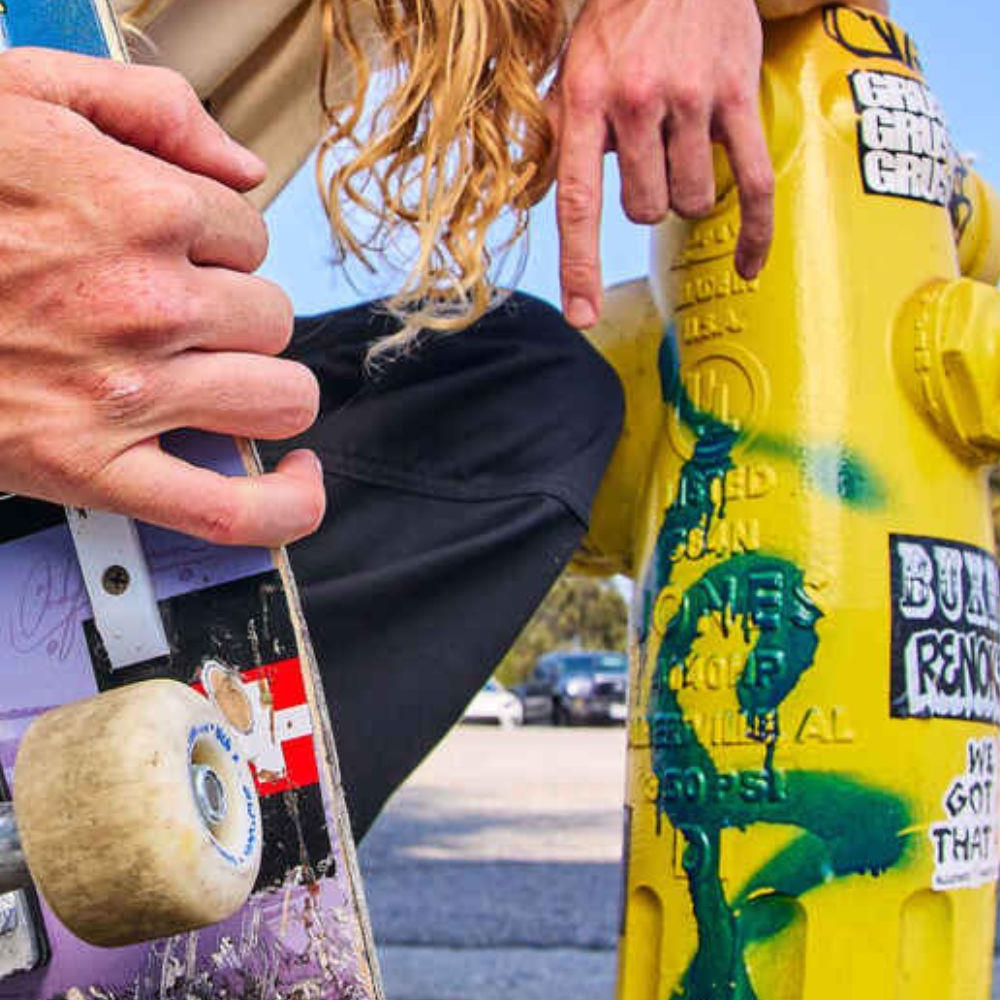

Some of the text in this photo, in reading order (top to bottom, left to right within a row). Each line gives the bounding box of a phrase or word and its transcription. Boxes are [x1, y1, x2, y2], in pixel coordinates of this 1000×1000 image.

[968, 741, 993, 774] WE
[945, 780, 993, 817] GOT
[932, 827, 992, 863] THAT
